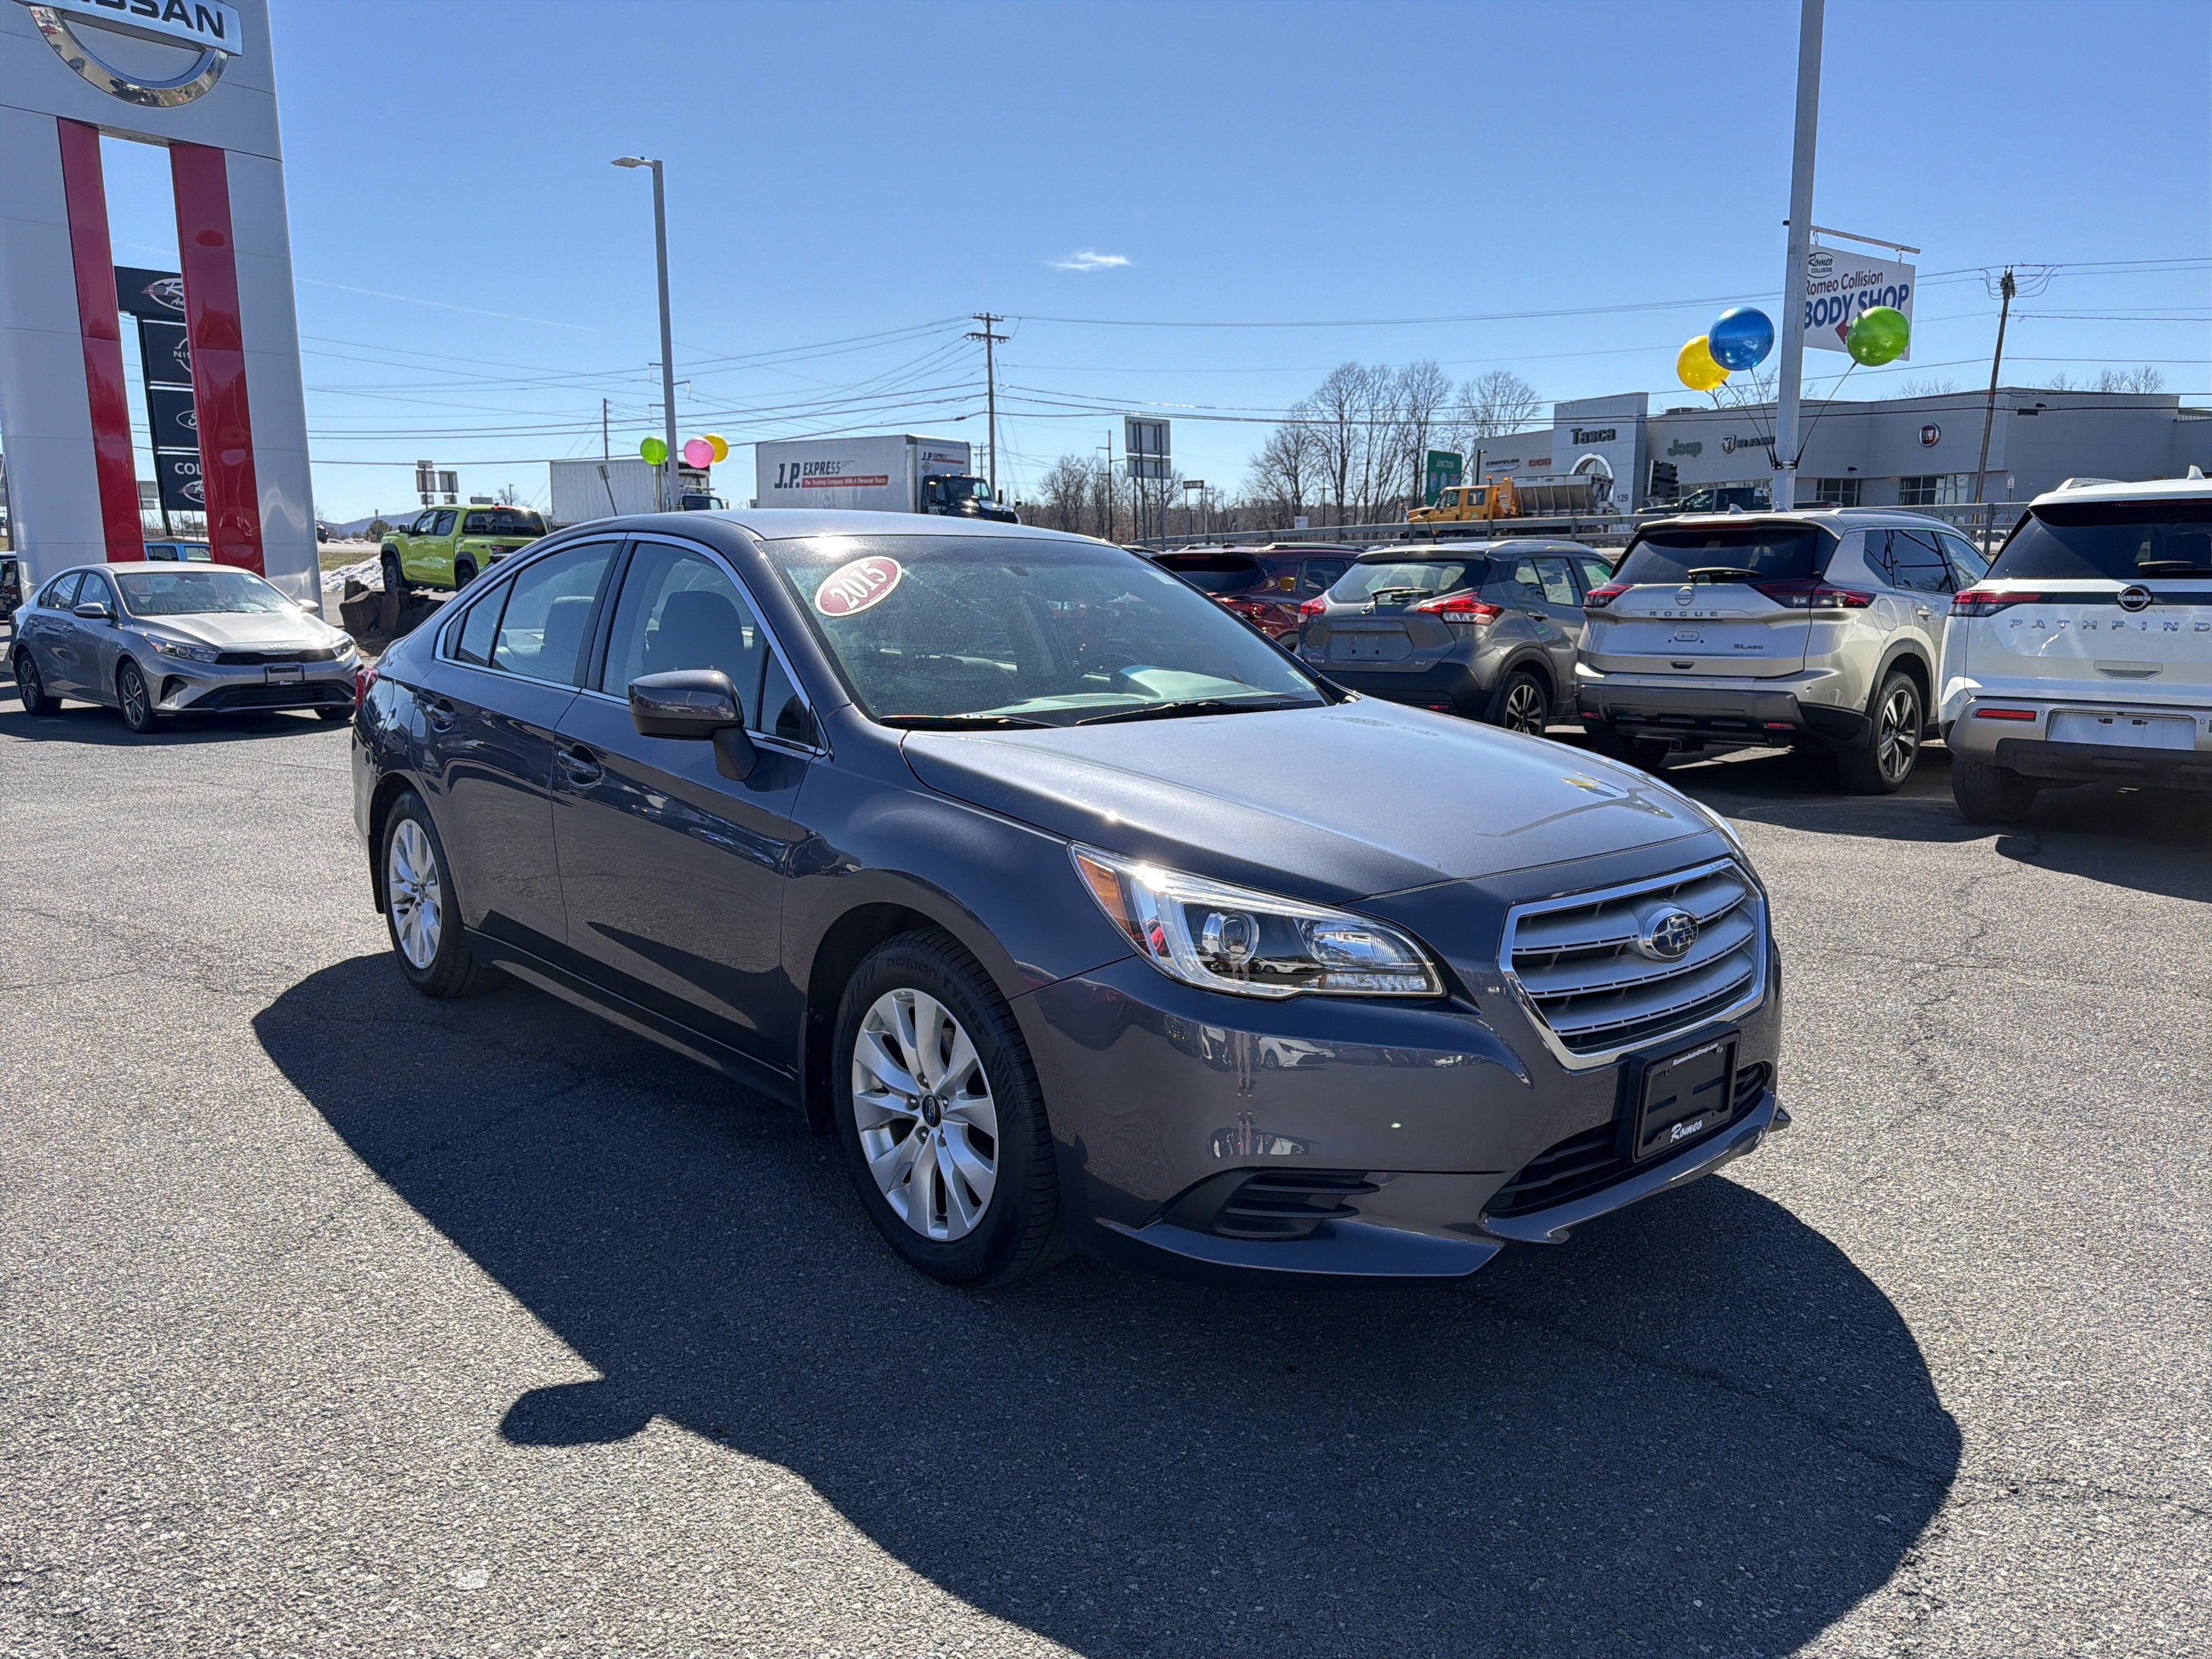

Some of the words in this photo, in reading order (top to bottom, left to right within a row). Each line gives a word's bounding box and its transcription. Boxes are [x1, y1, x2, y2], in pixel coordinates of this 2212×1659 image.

[1808, 253, 1833, 267] Romeo
[1841, 269, 1883, 290] Collision
[1804, 293, 1854, 329] BODY
[1858, 284, 1909, 313] SHOP
[1571, 428, 1616, 444] Tasca
[1668, 439, 1702, 458] Jeep
[774, 463, 800, 489] J.P.
[803, 461, 841, 476] EXPRESS
[1617, 494, 1629, 503] 129
[830, 561, 887, 610] 2015
[2010, 619, 2210, 631] PATHFIND
[1670, 1120, 1702, 1143] Romeo
